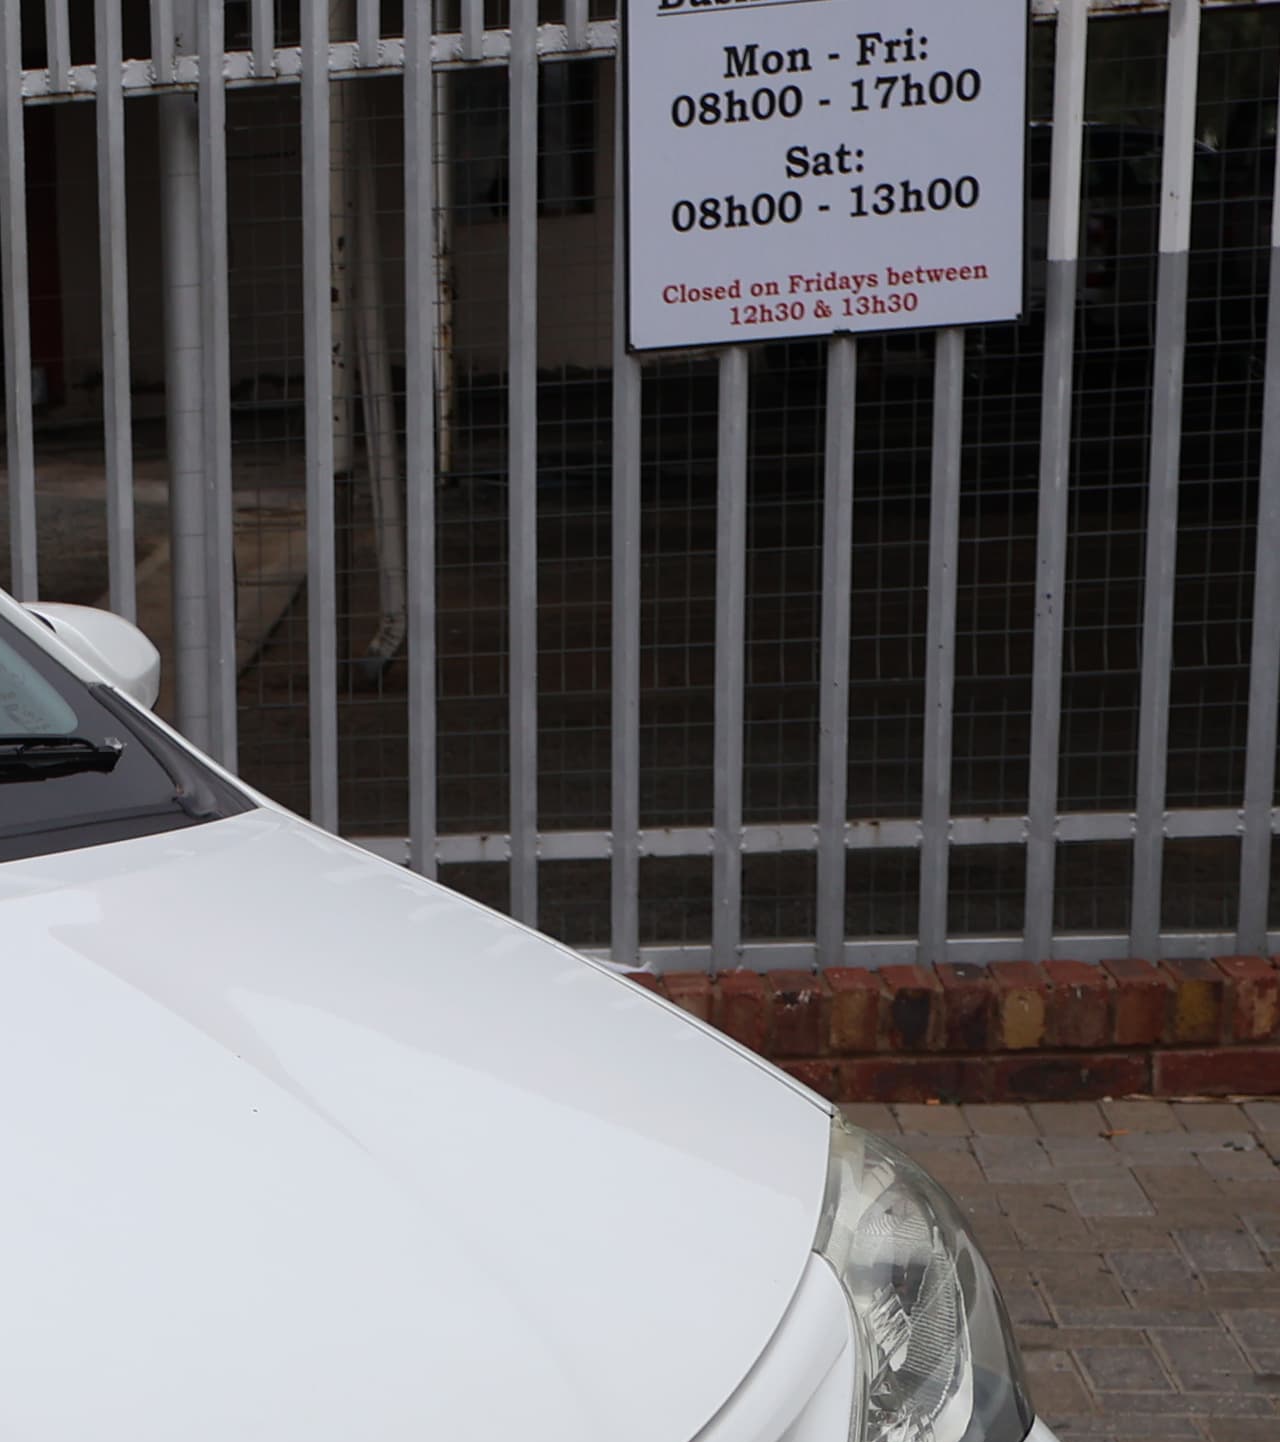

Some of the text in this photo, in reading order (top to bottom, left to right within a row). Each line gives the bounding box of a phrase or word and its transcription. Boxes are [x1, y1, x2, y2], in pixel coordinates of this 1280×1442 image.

[722, 27, 929, 79] Mon - Fri:
[670, 68, 982, 128] 08h00 - 17h00
[784, 143, 865, 179] Sat:
[670, 175, 980, 233] 08h00 - 13h00
[662, 263, 989, 305] Closed on Fridays between
[729, 292, 919, 326] 12h30 & 13h30
